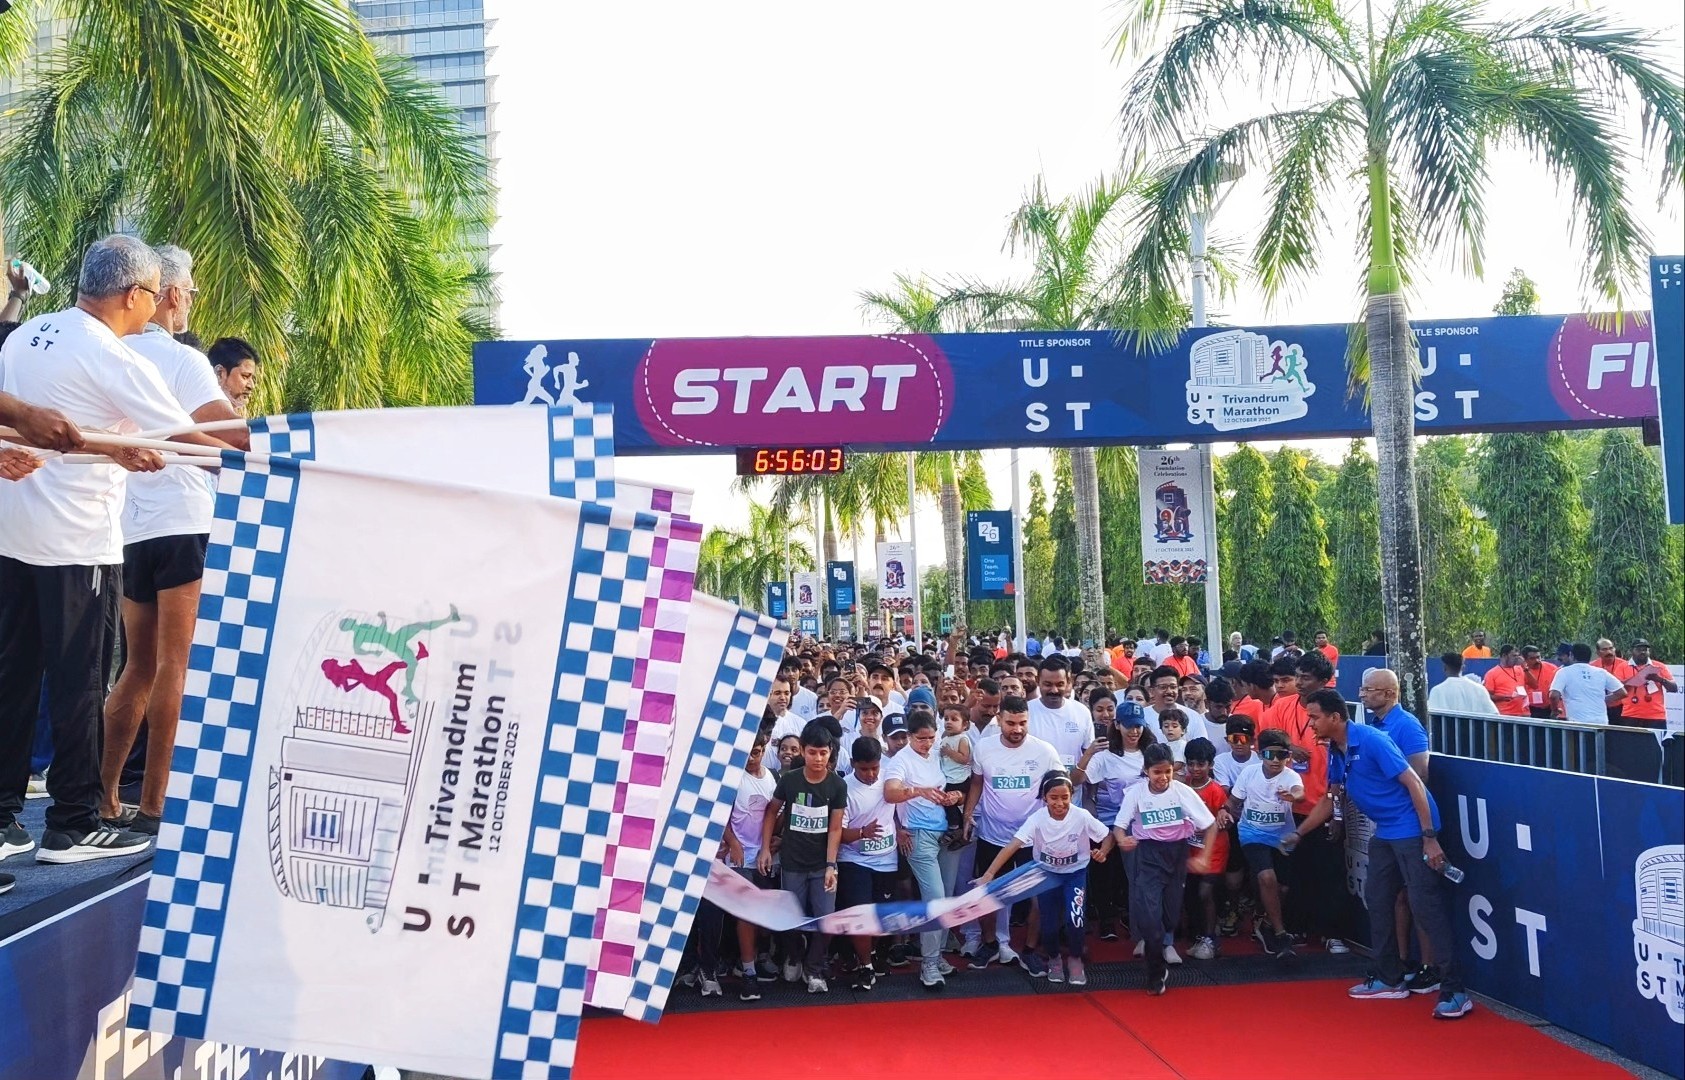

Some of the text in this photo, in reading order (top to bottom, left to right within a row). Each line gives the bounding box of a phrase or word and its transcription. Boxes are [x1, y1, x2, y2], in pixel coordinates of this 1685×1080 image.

[1434, 326, 1480, 336] SPONSOR
[1019, 338, 1091, 348] TITLE SPONSOR
[671, 364, 917, 415] START
[1222, 393, 1289, 405] Trivandrum
[1223, 406, 1280, 417] Marathon
[755, 449, 841, 472] 6:56:03
[424, 663, 477, 845] Trivandrum
[457, 695, 506, 851] Marathon
[491, 760, 513, 832] OCTOBER
[504, 720, 520, 758] 2025
[997, 777, 1026, 789] 52674
[795, 816, 824, 829] 52176
[1146, 808, 1177, 824] 51999
[1250, 812, 1280, 823] 52215
[864, 837, 890, 851] 52583
[1044, 855, 1074, 866] 51911
